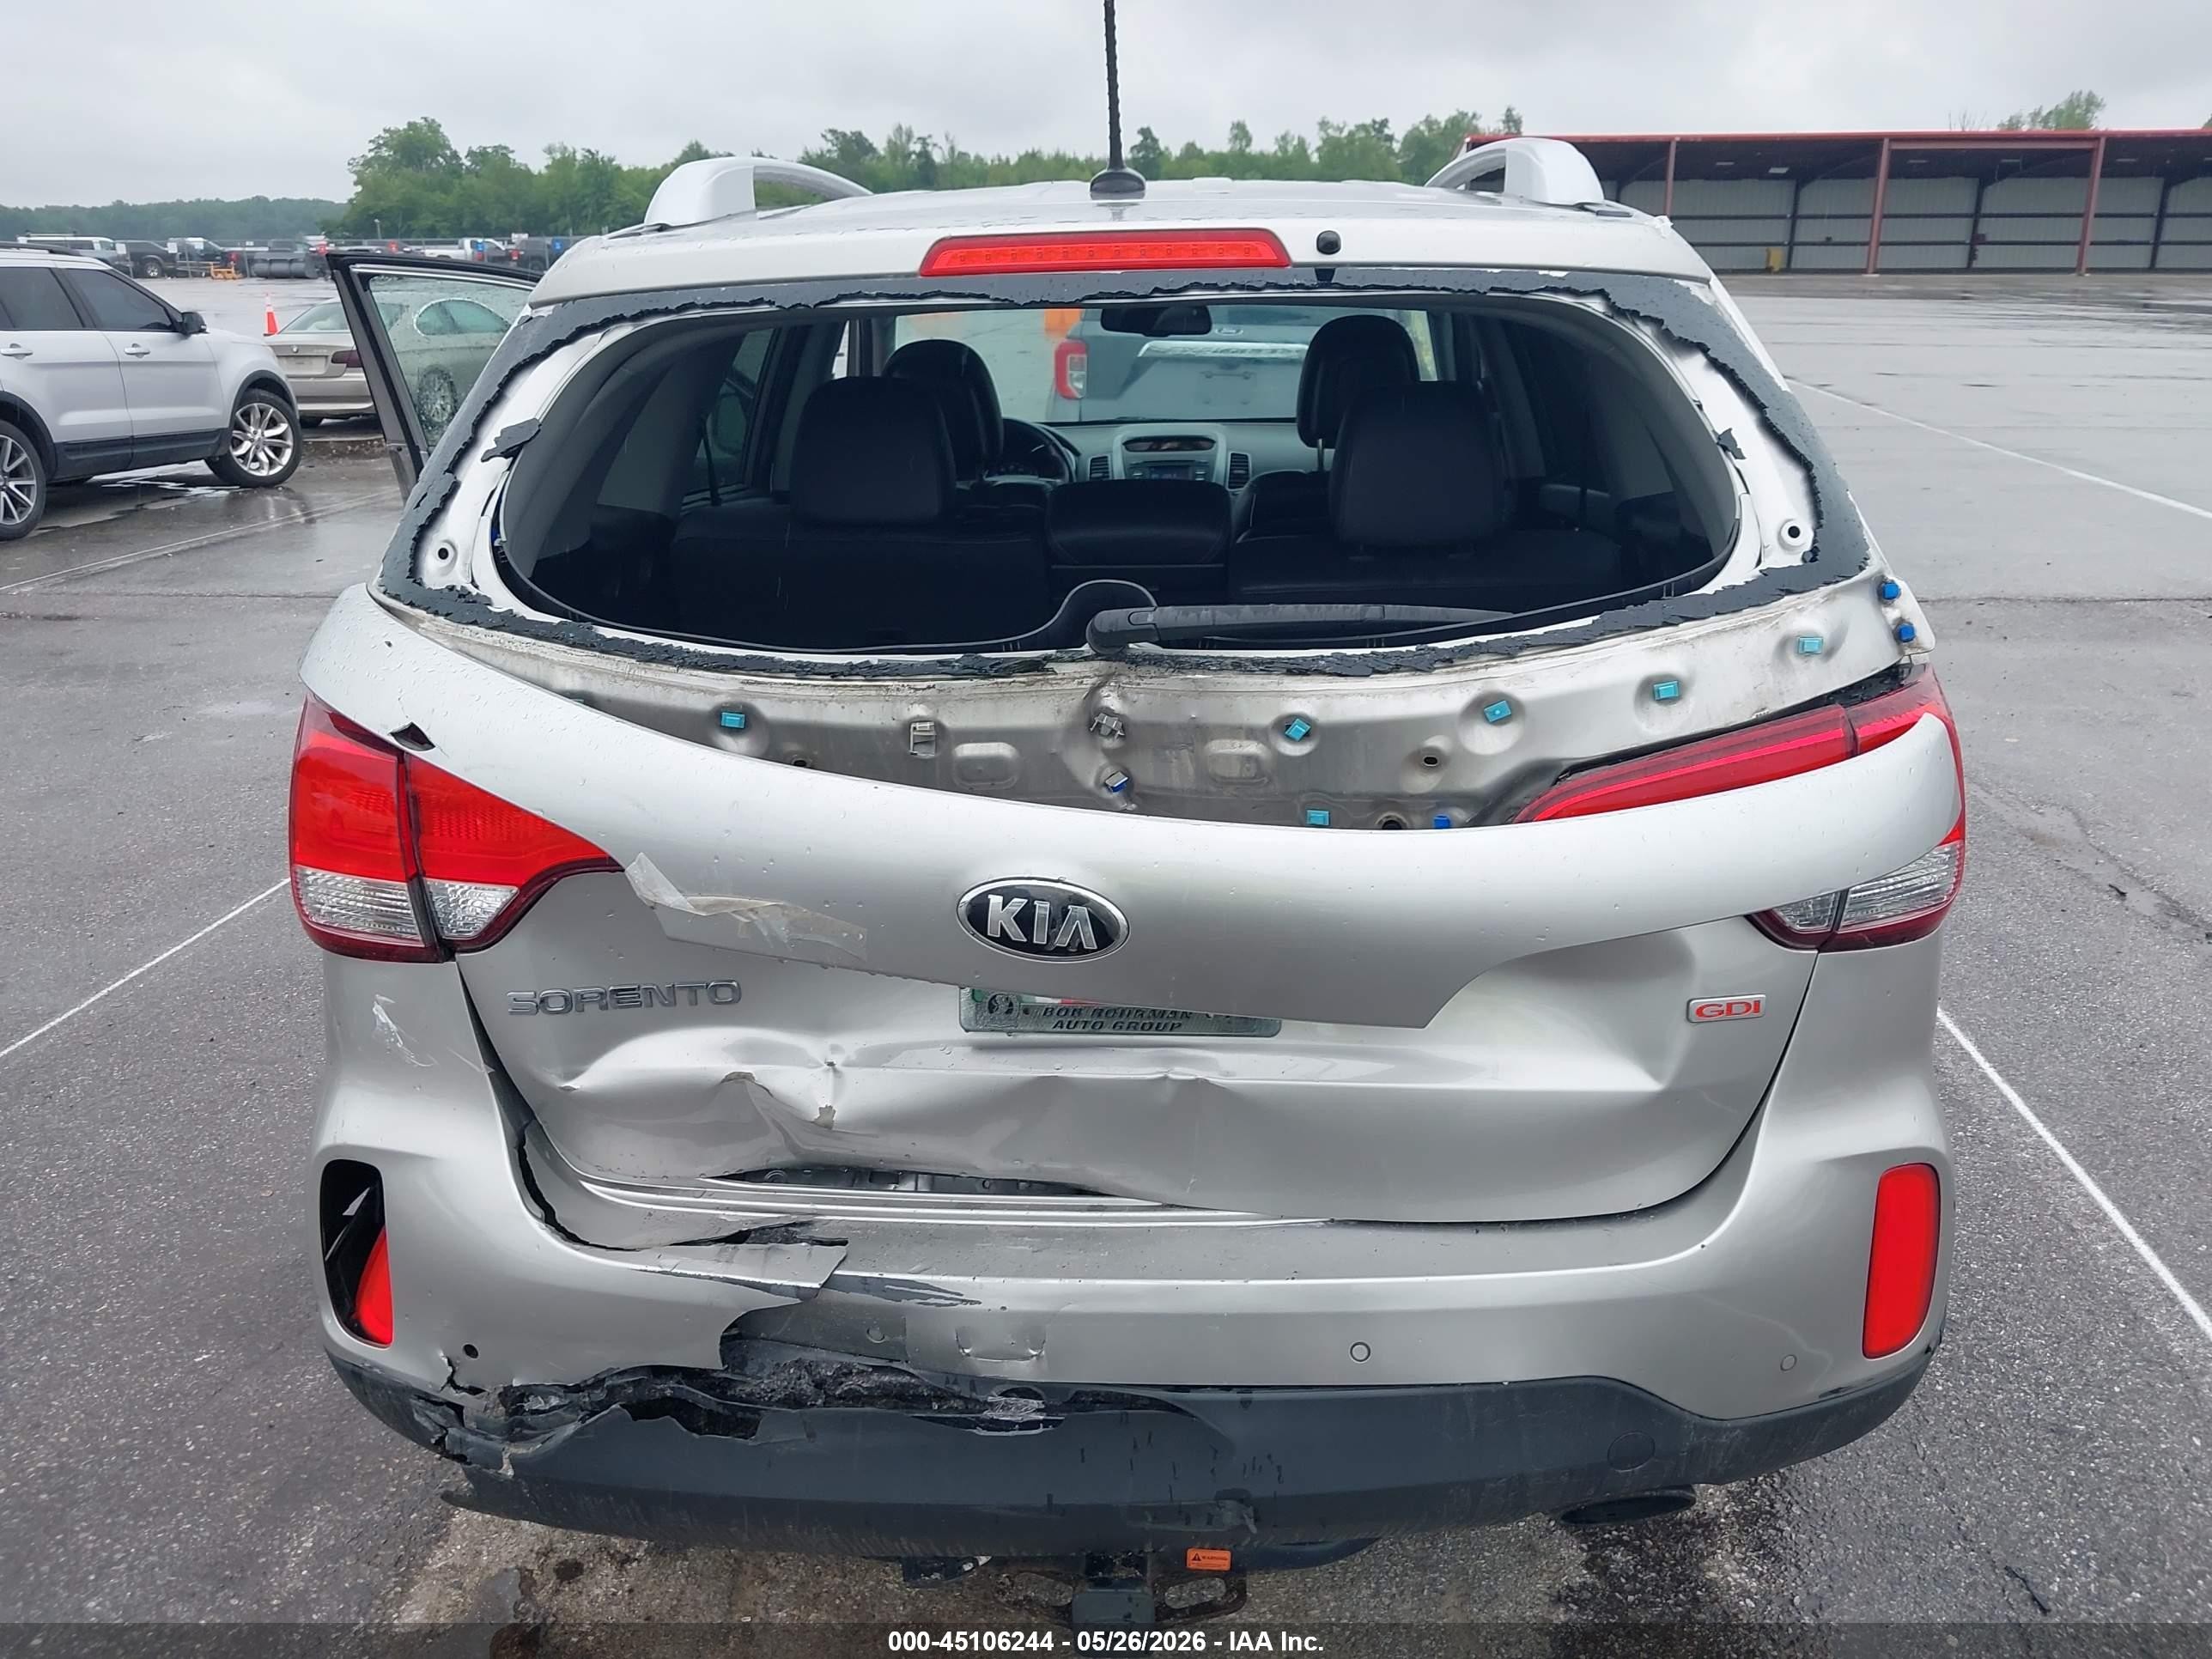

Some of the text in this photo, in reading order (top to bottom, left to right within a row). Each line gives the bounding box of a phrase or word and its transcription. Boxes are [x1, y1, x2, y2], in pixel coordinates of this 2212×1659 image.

[987, 894, 1098, 950] KIA
[507, 979, 743, 1016] SORENTO
[1695, 1000, 1761, 1018] GDI
[1052, 1019, 1182, 1032] AUTO GROUP
